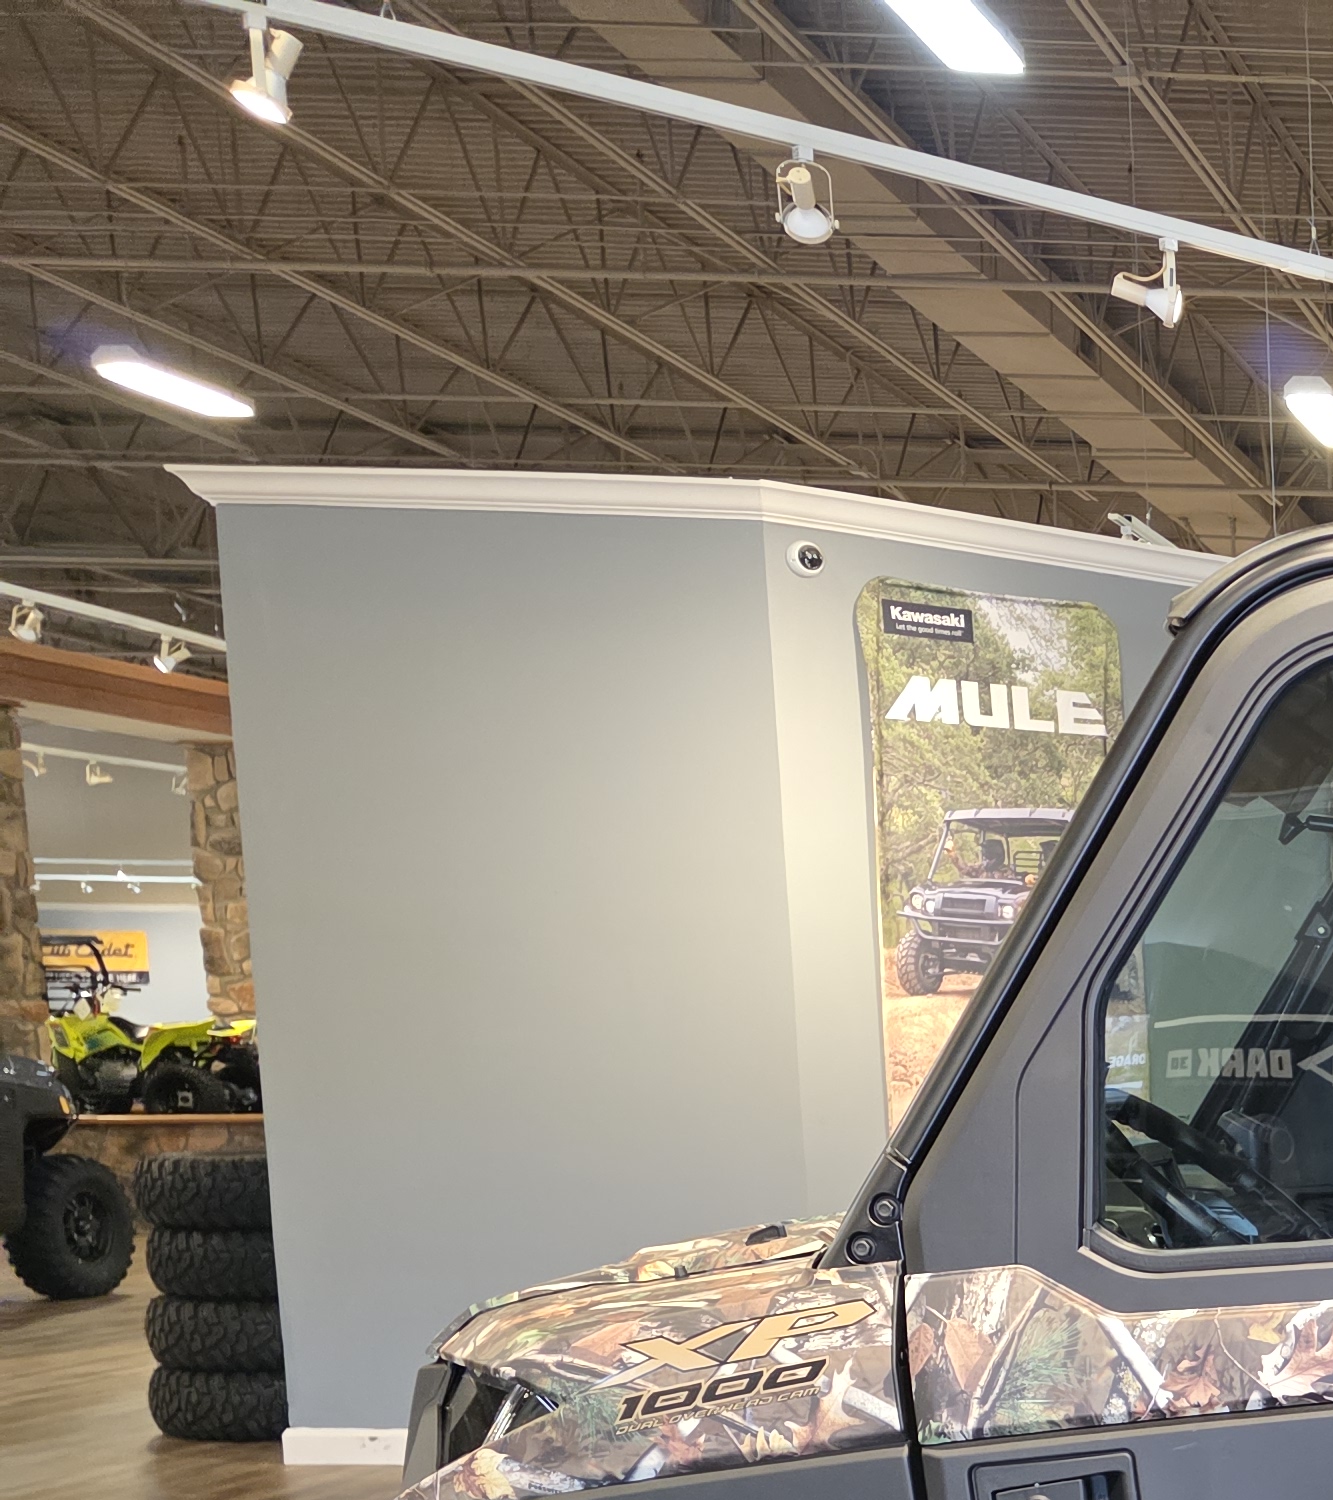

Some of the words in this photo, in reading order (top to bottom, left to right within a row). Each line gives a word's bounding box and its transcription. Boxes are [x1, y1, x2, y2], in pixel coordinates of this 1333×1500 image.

[890, 605, 966, 629] Kawasaki
[906, 623, 917, 632] the
[918, 624, 933, 636] good
[934, 627, 951, 636] times
[885, 675, 1109, 737] MULE
[584, 1299, 877, 1394] XP
[615, 1355, 830, 1425] 1000
[616, 1417, 663, 1436] DUAL
[669, 1397, 775, 1424] OVERHEAD
[777, 1386, 821, 1403] CAM
